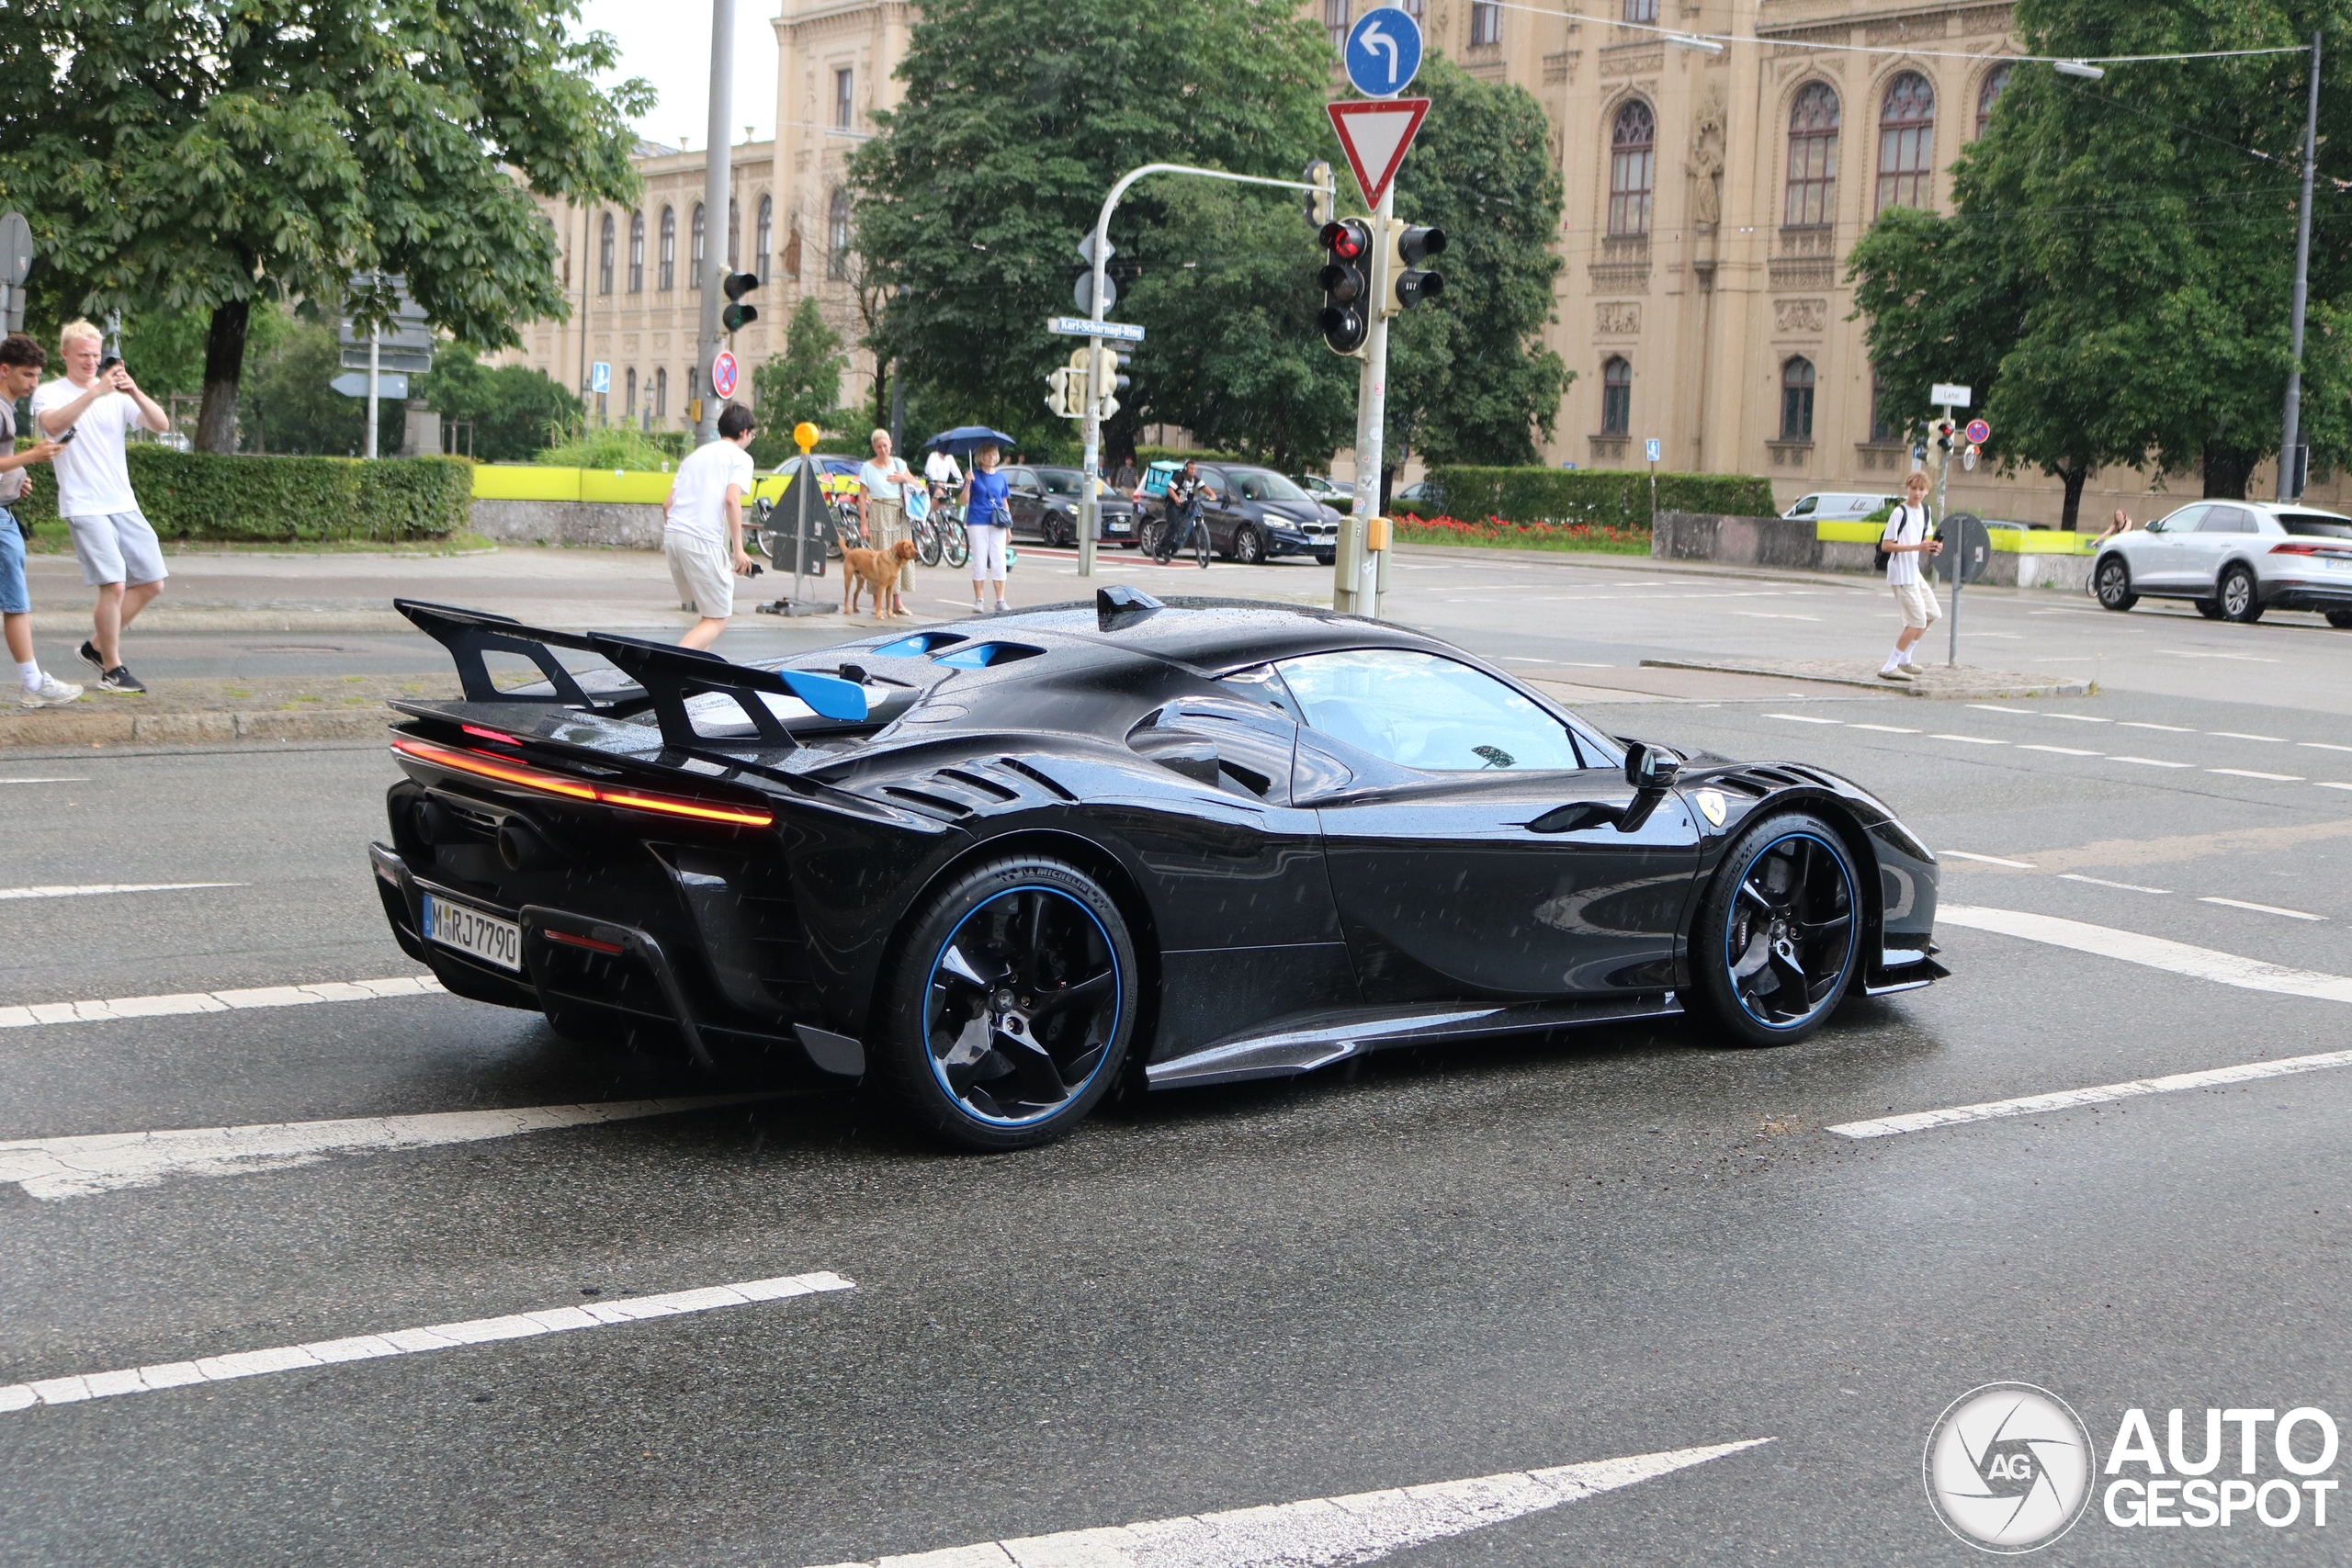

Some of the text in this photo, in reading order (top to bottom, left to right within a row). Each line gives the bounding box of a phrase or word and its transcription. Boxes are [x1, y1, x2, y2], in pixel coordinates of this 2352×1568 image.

[1060, 320, 1142, 340] Karl-Scharnagl-Ring
[1036, 868, 1091, 896] MICHELIN
[433, 902, 441, 936] M
